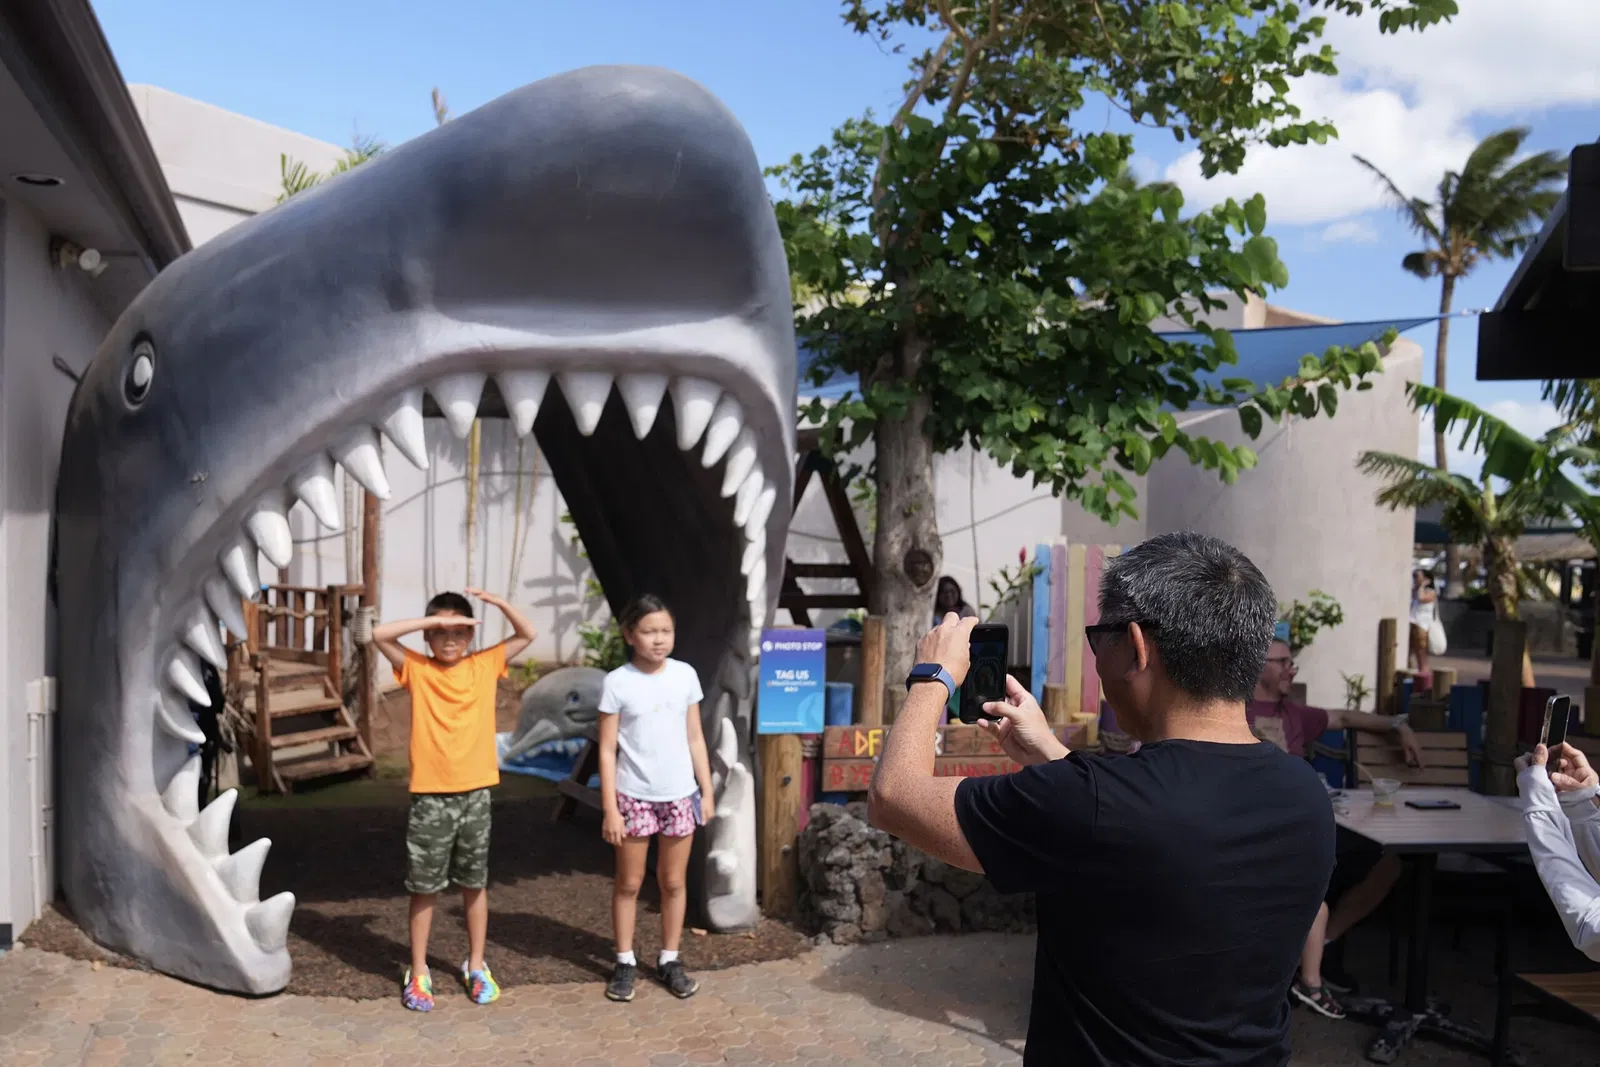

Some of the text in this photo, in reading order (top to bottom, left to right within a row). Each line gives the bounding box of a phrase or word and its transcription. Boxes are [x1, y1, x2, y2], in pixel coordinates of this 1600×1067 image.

[775, 641, 823, 651] PHOTO STOP
[774, 669, 810, 681] TAG US
